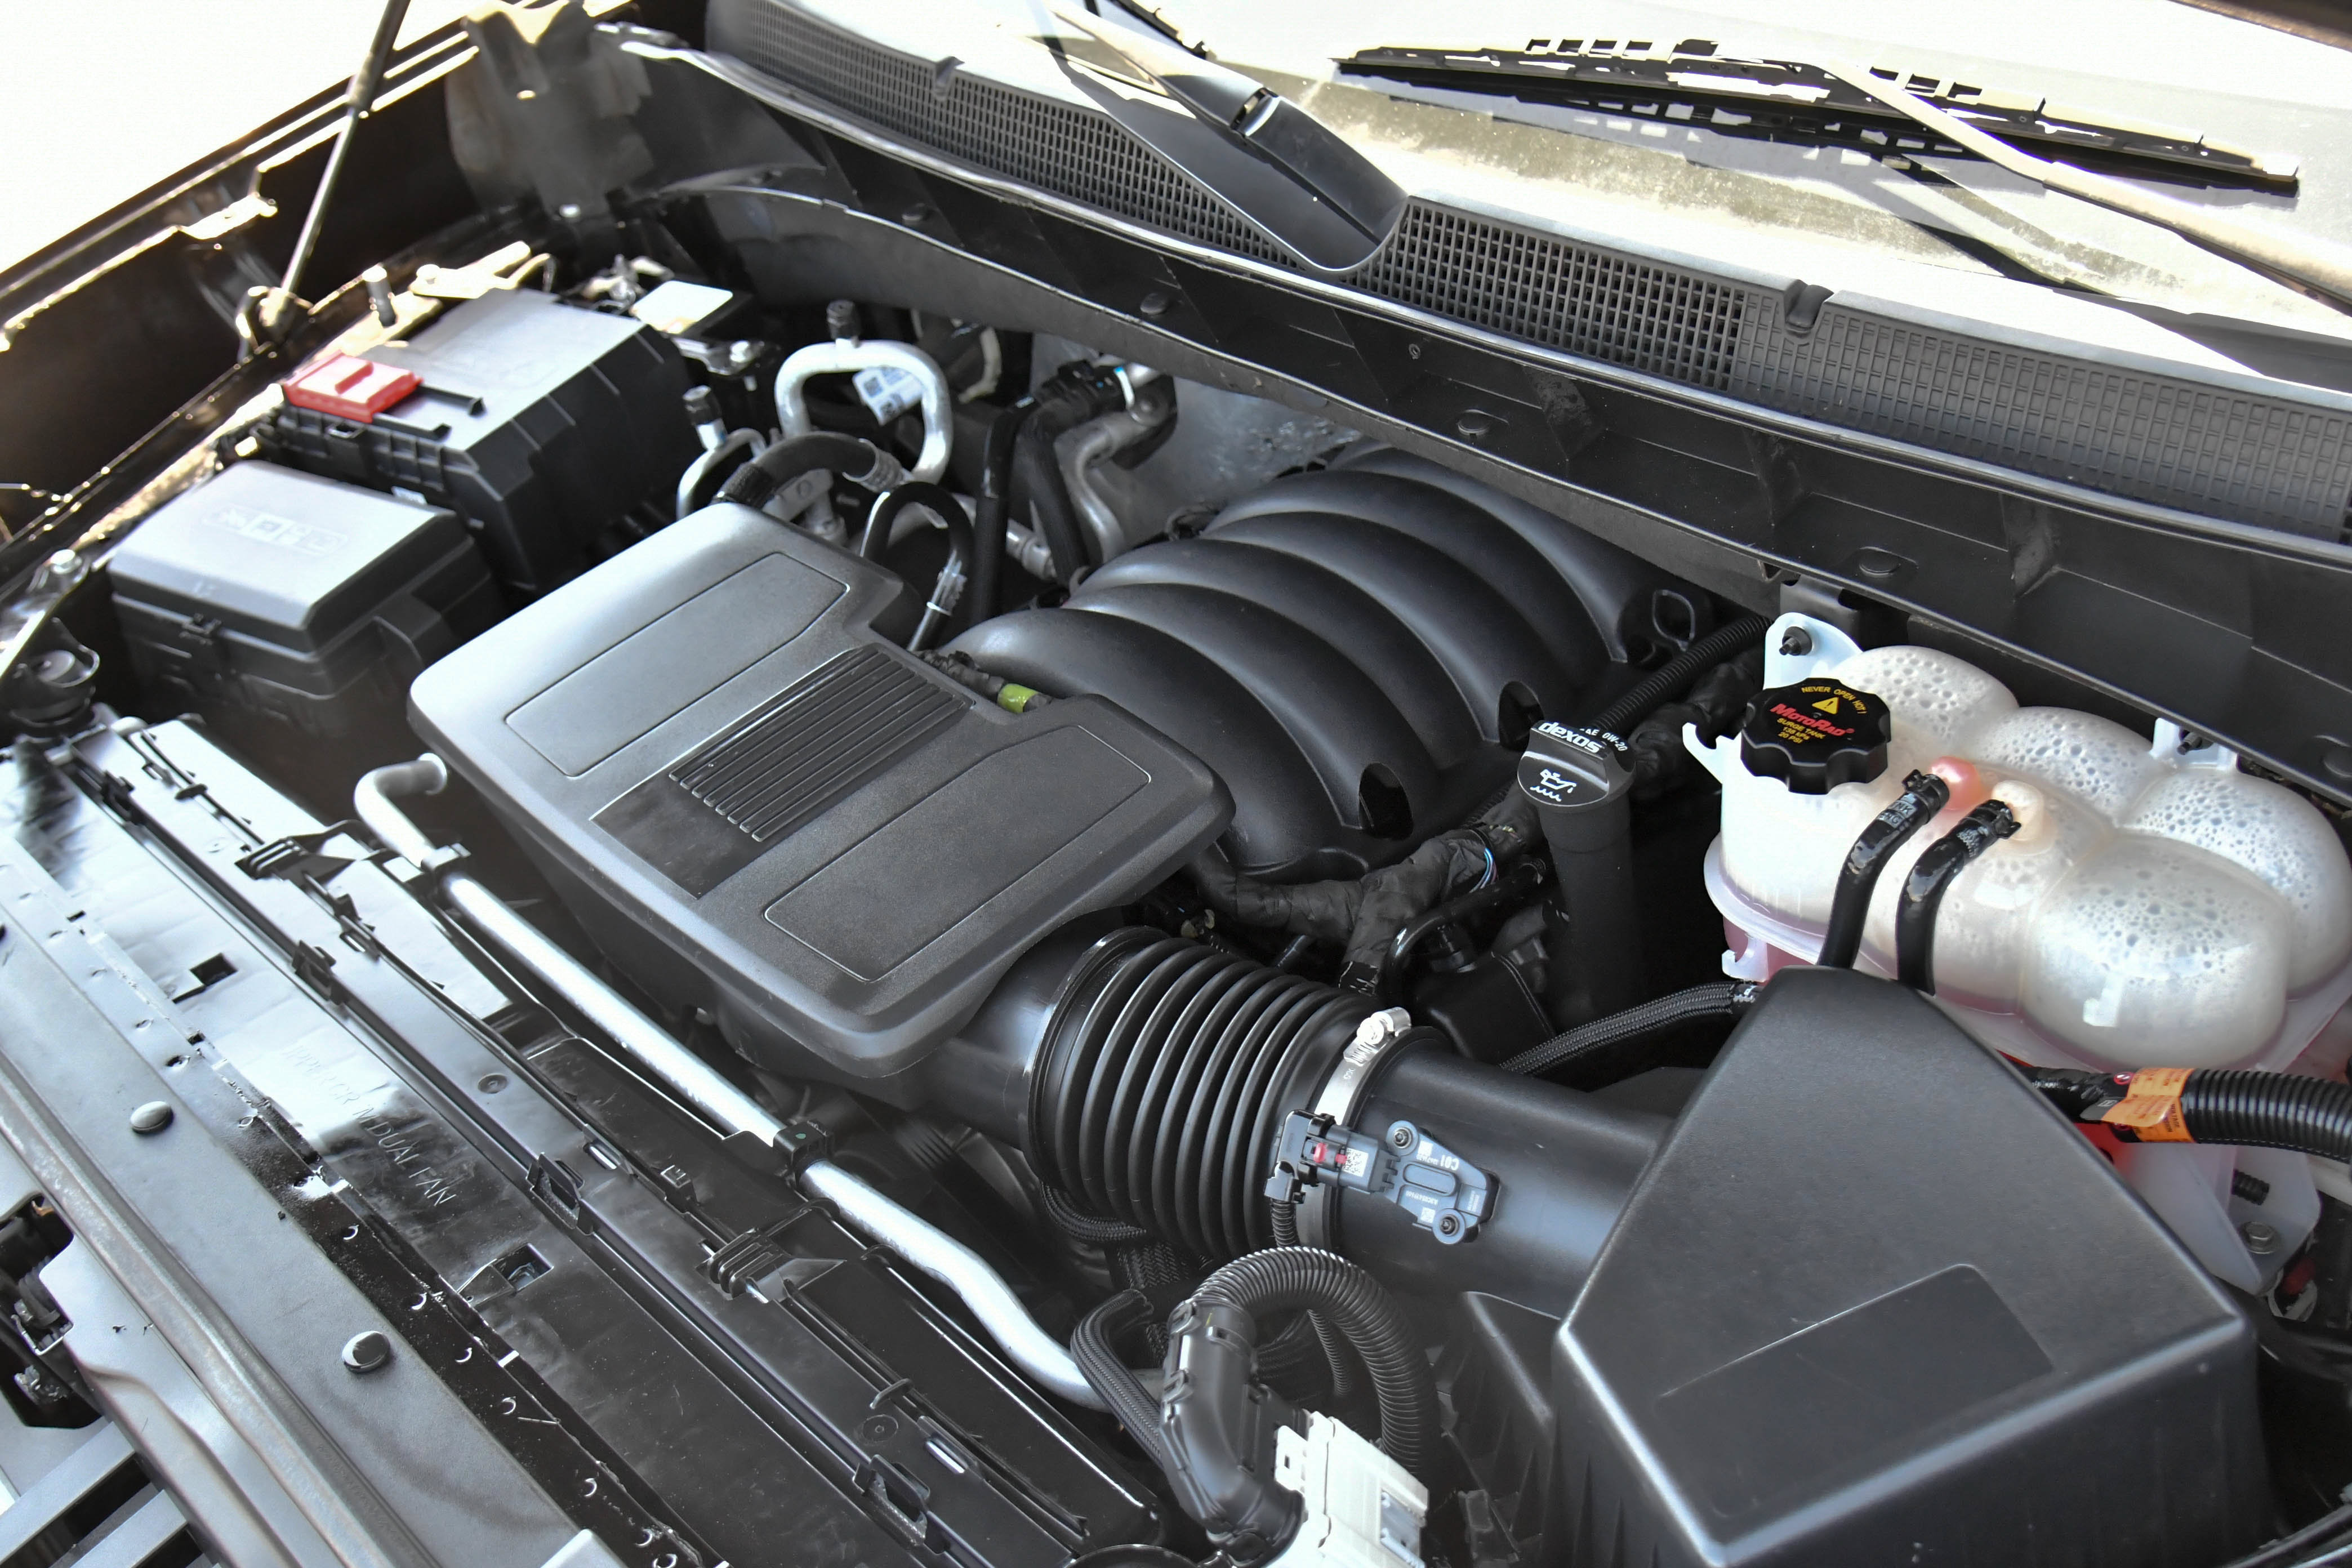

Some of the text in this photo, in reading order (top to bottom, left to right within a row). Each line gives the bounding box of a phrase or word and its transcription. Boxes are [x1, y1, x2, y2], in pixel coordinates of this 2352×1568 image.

[1833, 689, 1856, 701] OPEN
[1777, 718, 1826, 739] SURGE TANK
[1783, 727, 1796, 735] 138
[1538, 721, 1603, 753] dexos
[1602, 732, 1628, 752] 0W-20
[1789, 735, 1803, 743] PSI
[1440, 1155, 1459, 1170] C01
